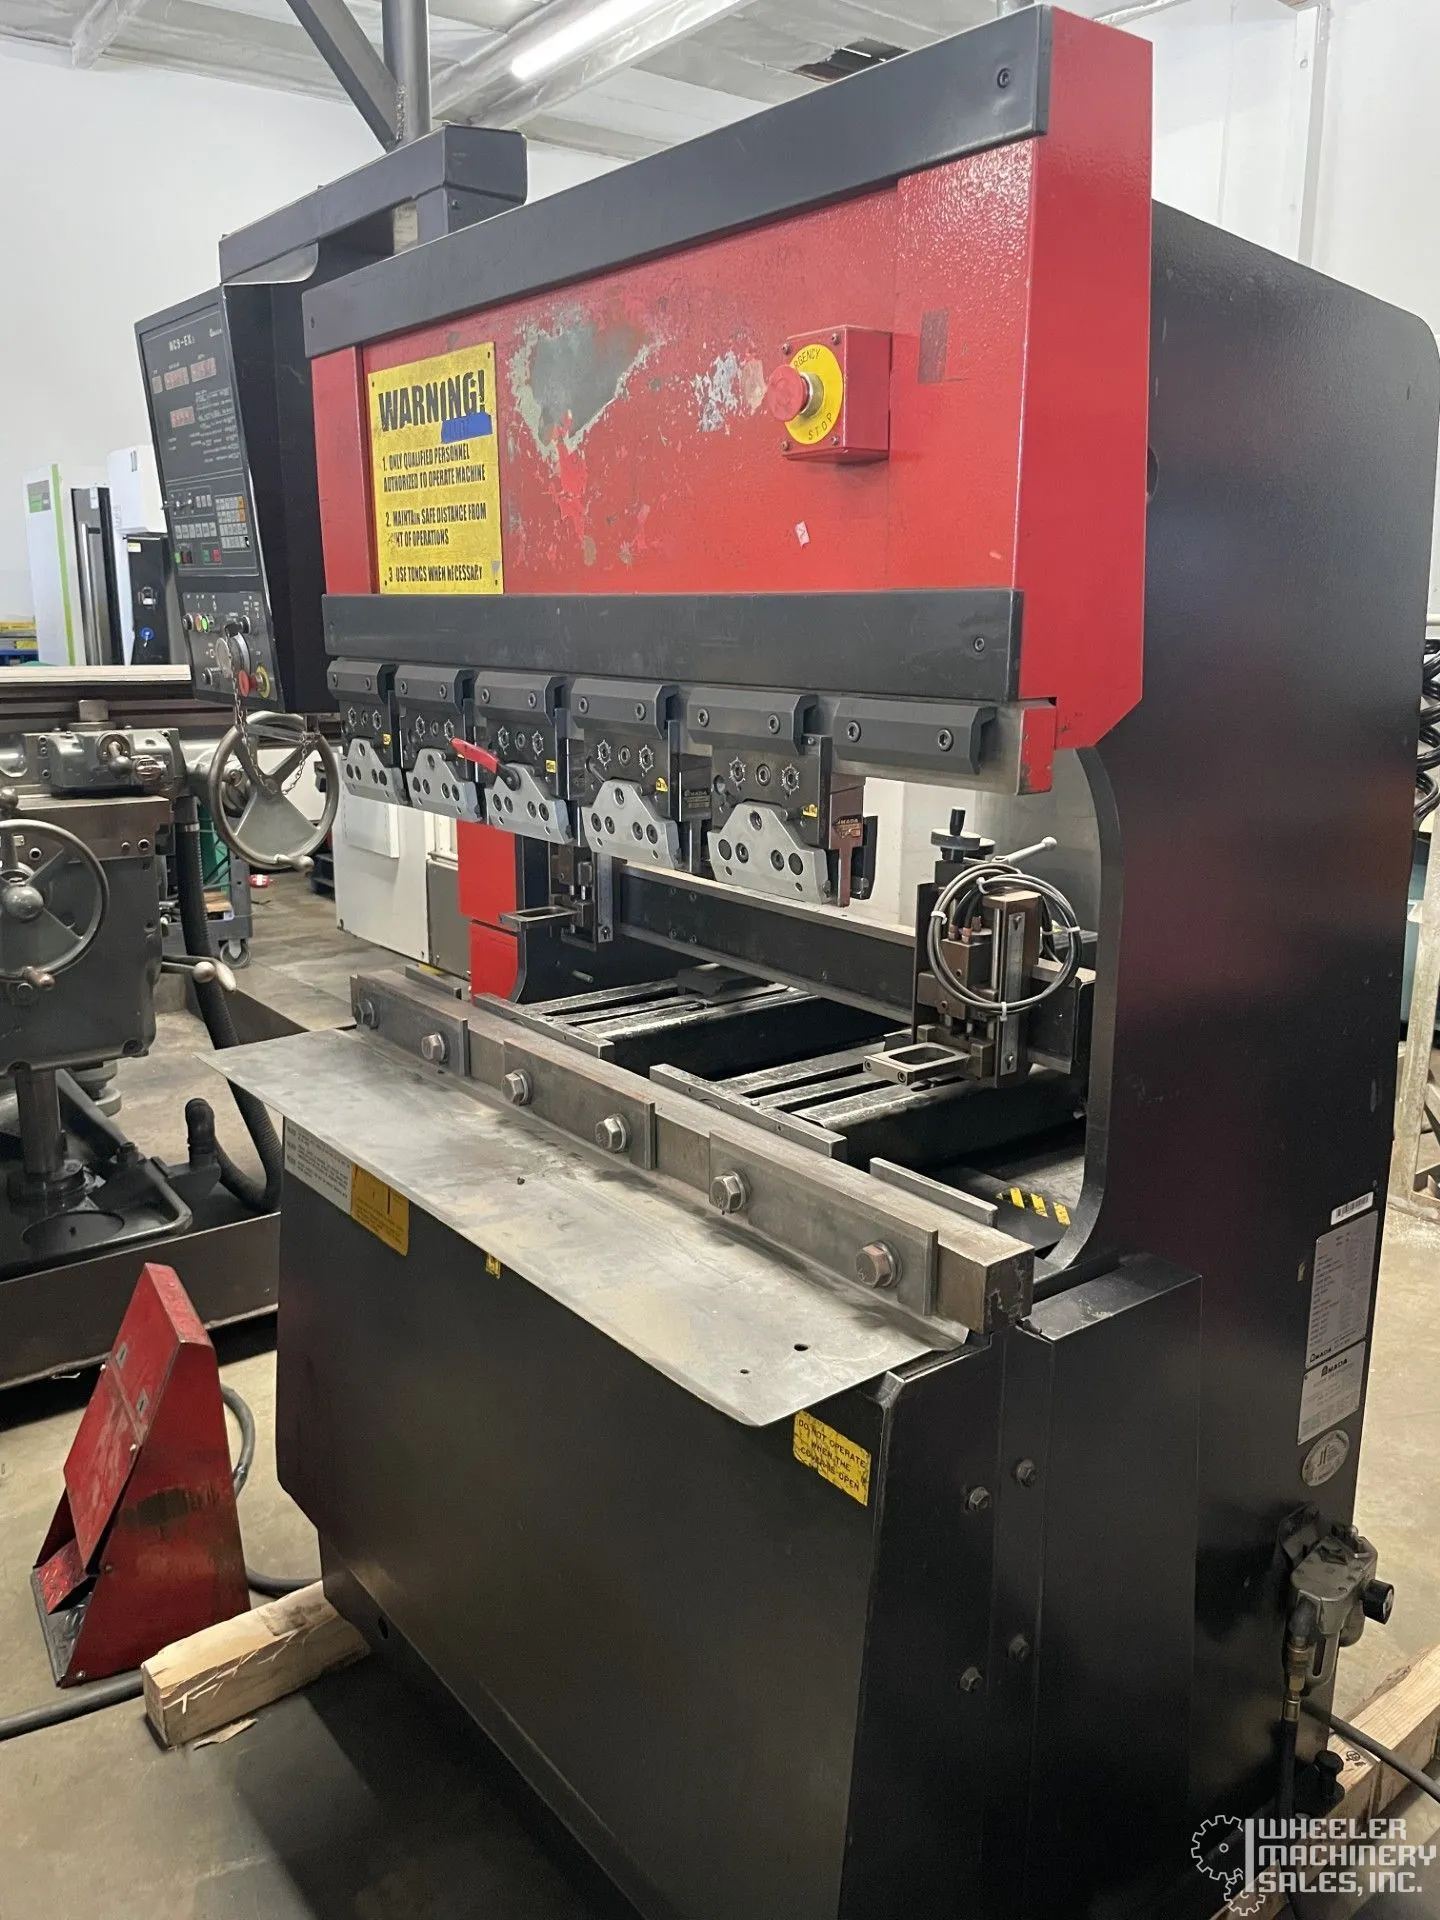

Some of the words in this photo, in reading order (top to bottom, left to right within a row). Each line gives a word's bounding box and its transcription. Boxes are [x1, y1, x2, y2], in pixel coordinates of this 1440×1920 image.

[793, 348, 821, 370] RGENCY
[378, 369, 485, 432] WARNING!
[808, 412, 834, 440] STOP
[389, 453, 402, 471] ONLY
[403, 448, 433, 470] QUALIFIED
[434, 443, 470, 464] PERSONNEL
[384, 473, 418, 492] AUTHORIZED
[420, 471, 428, 488] TO
[429, 468, 455, 487] OPERATE
[456, 464, 485, 484] MACHINE
[421, 507, 436, 524] SAFE
[437, 504, 467, 523] DISTANCE
[468, 502, 487, 520] FROM
[405, 531, 412, 547] OF
[413, 528, 449, 546] OPERATIONS
[396, 566, 406, 582] USE
[407, 566, 427, 582] TONGS
[428, 565, 446, 581] WHEN
[447, 564, 483, 581] NECESSARY
[798, 1419, 809, 1430] DO
[811, 1427, 827, 1442] NOT
[829, 1440, 866, 1467] OPERATE
[811, 1442, 832, 1459] WHEN
[835, 1456, 850, 1471] THE
[838, 1473, 859, 1491] OPEN
